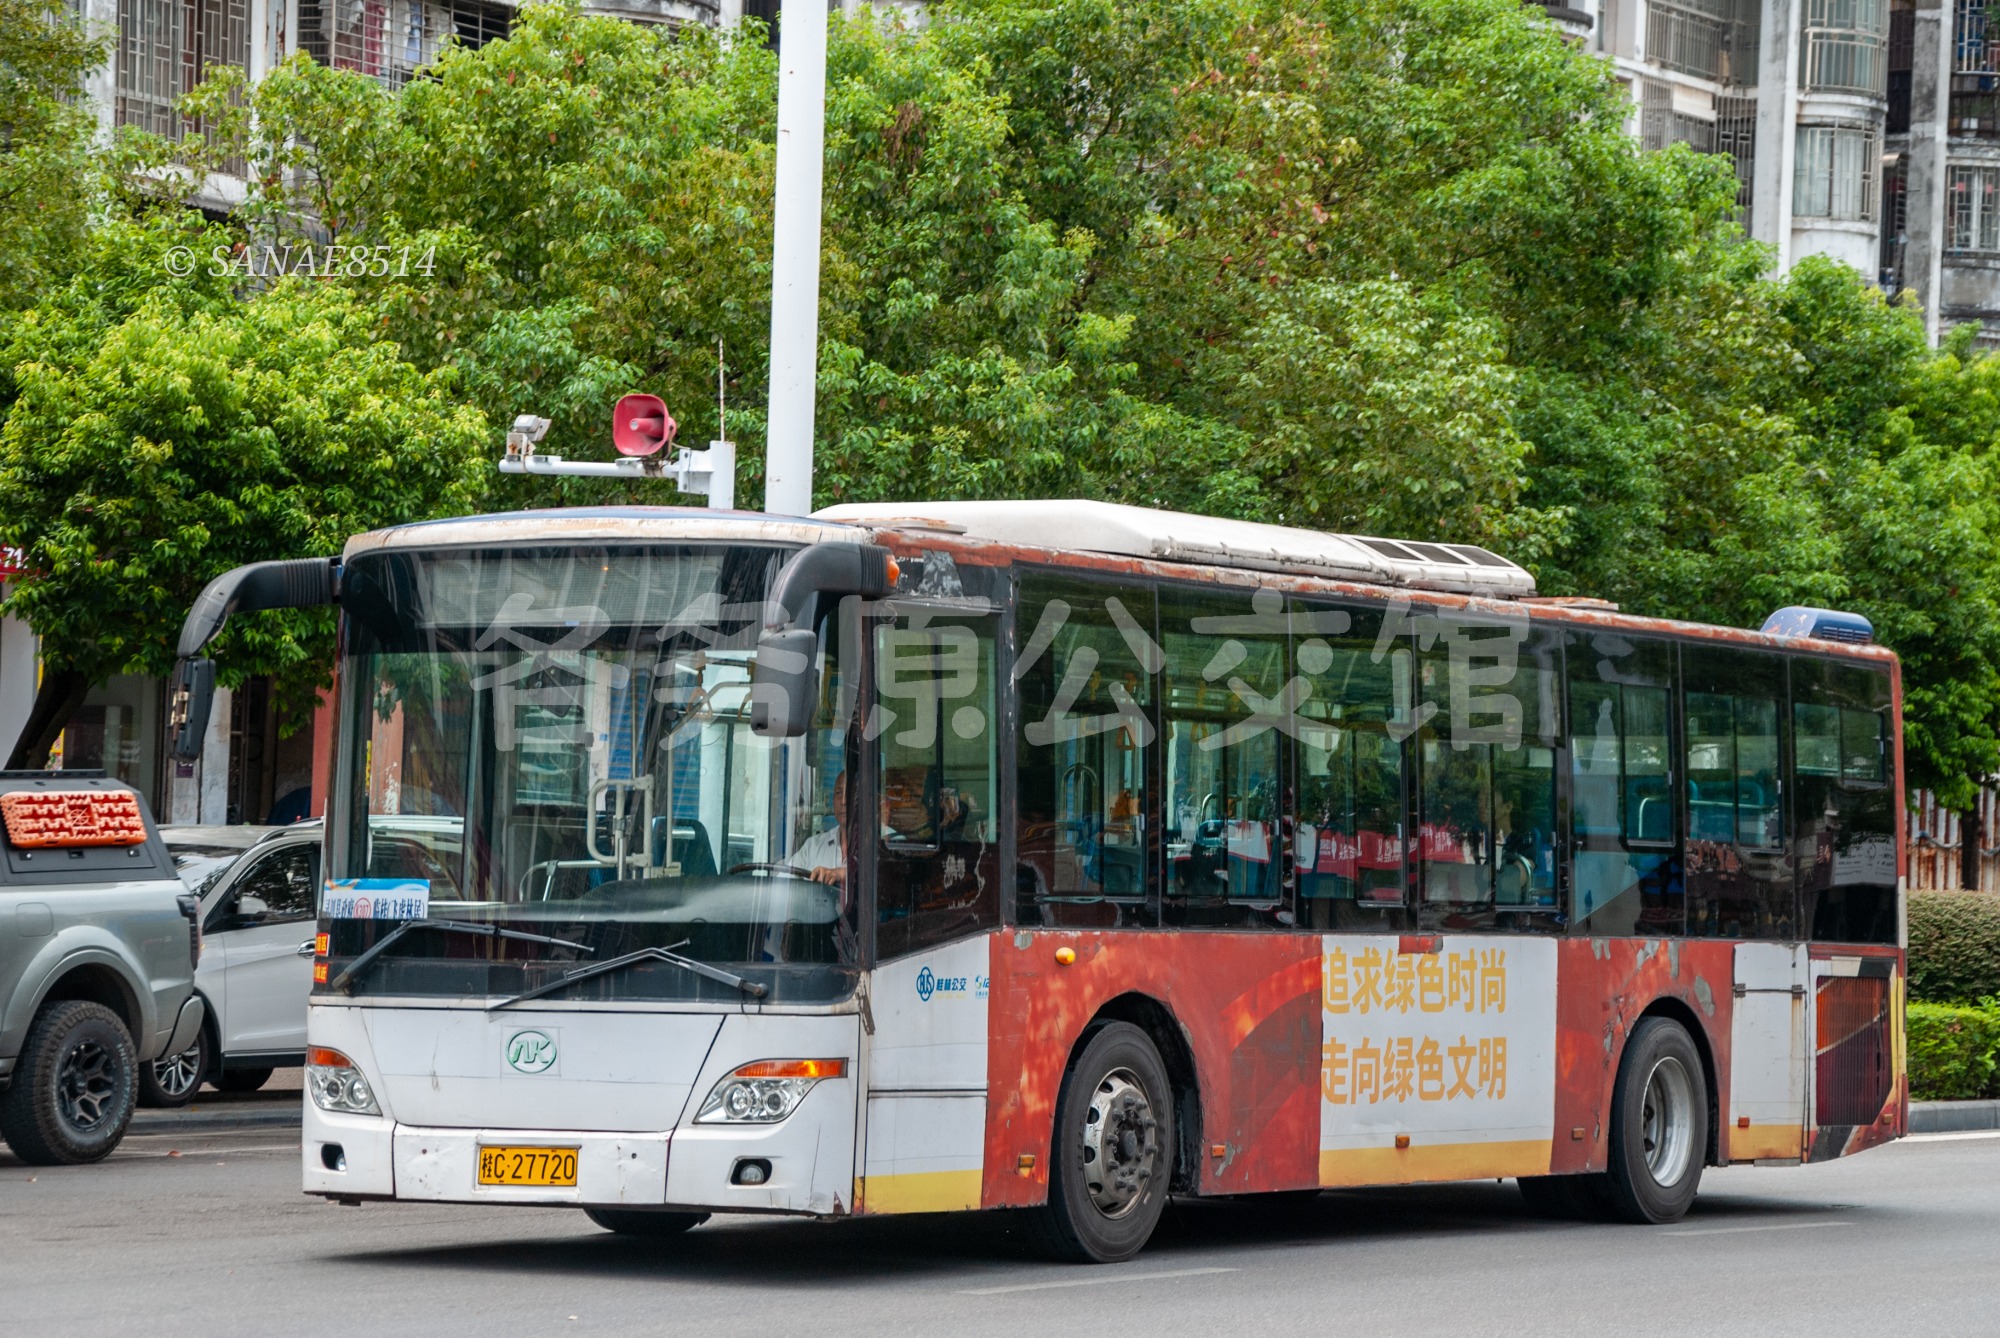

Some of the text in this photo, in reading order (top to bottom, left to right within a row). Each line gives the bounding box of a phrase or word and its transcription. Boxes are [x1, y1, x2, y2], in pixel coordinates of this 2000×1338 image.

[936, 978, 967, 991] 桂林公交
[1322, 946, 1506, 1014] 追求绿色时尚
[1321, 1034, 1507, 1105] 走向绿色文明
